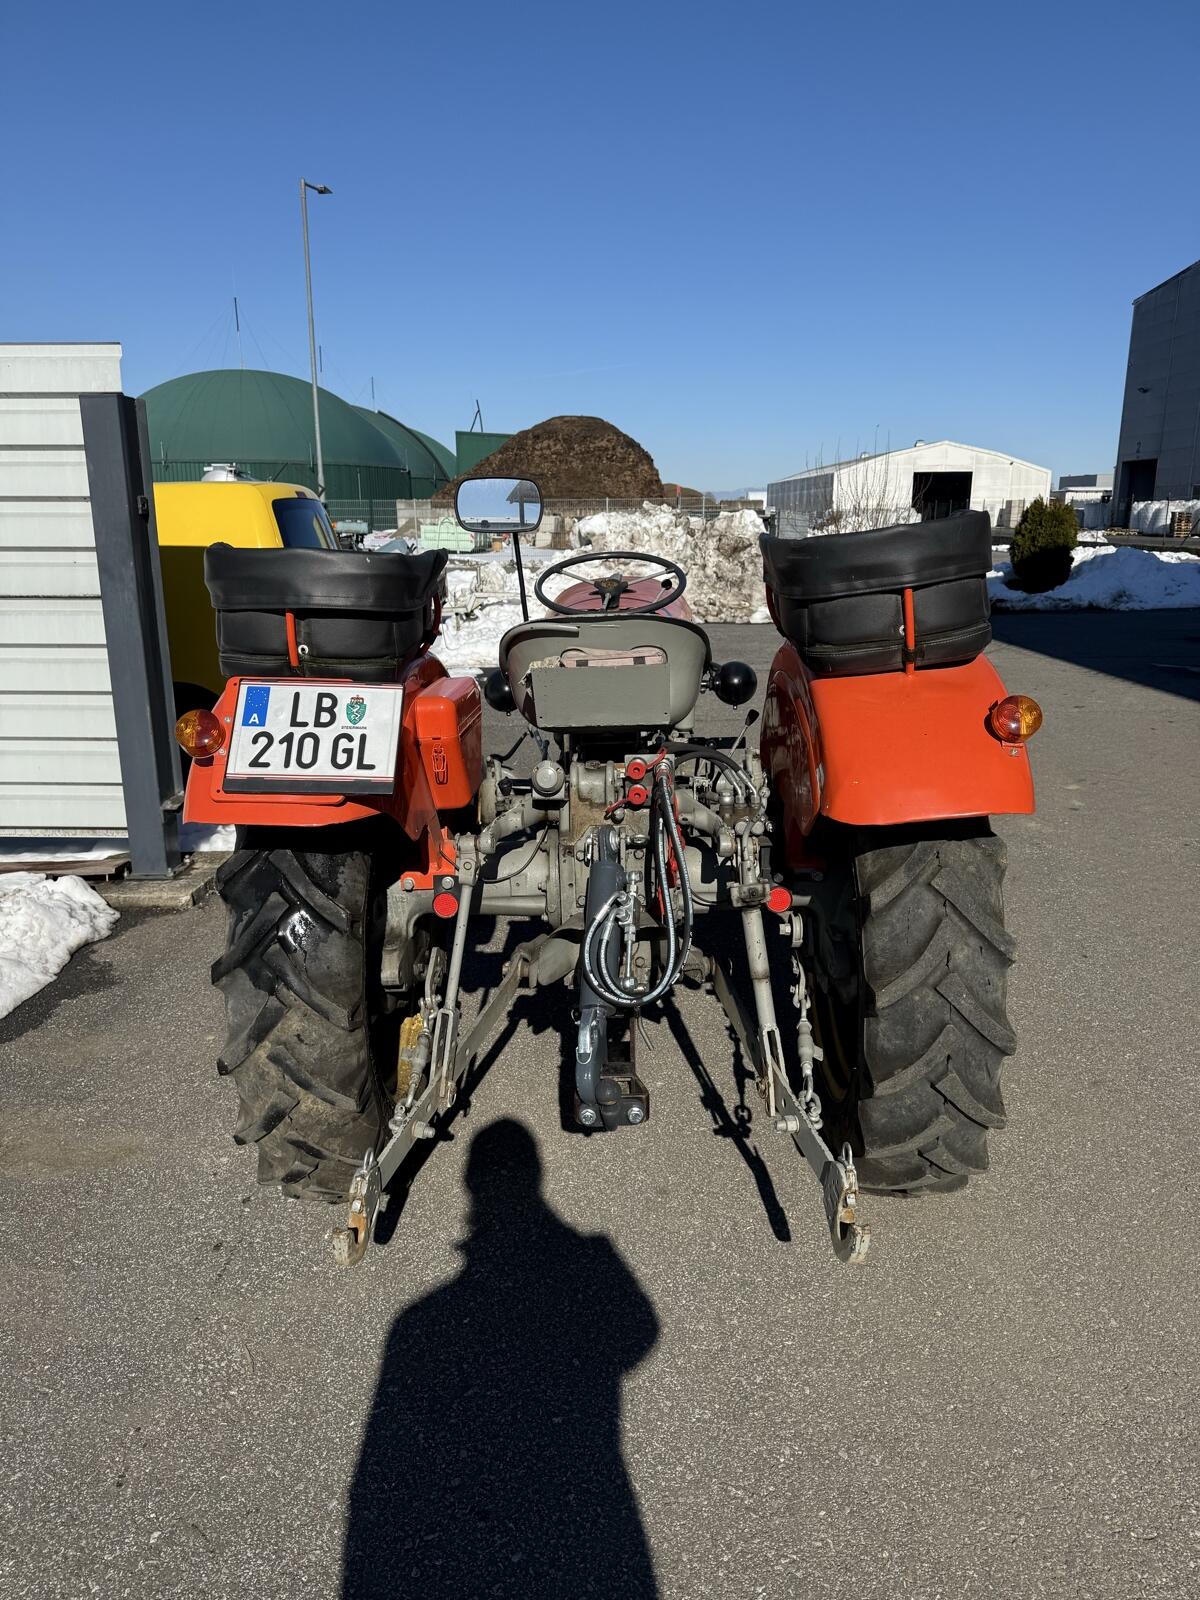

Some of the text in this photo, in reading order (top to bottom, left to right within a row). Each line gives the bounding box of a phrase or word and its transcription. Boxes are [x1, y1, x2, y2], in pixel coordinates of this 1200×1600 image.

[248, 713, 260, 725] A
[290, 691, 339, 728] LB
[248, 730, 377, 771] 210 GL
